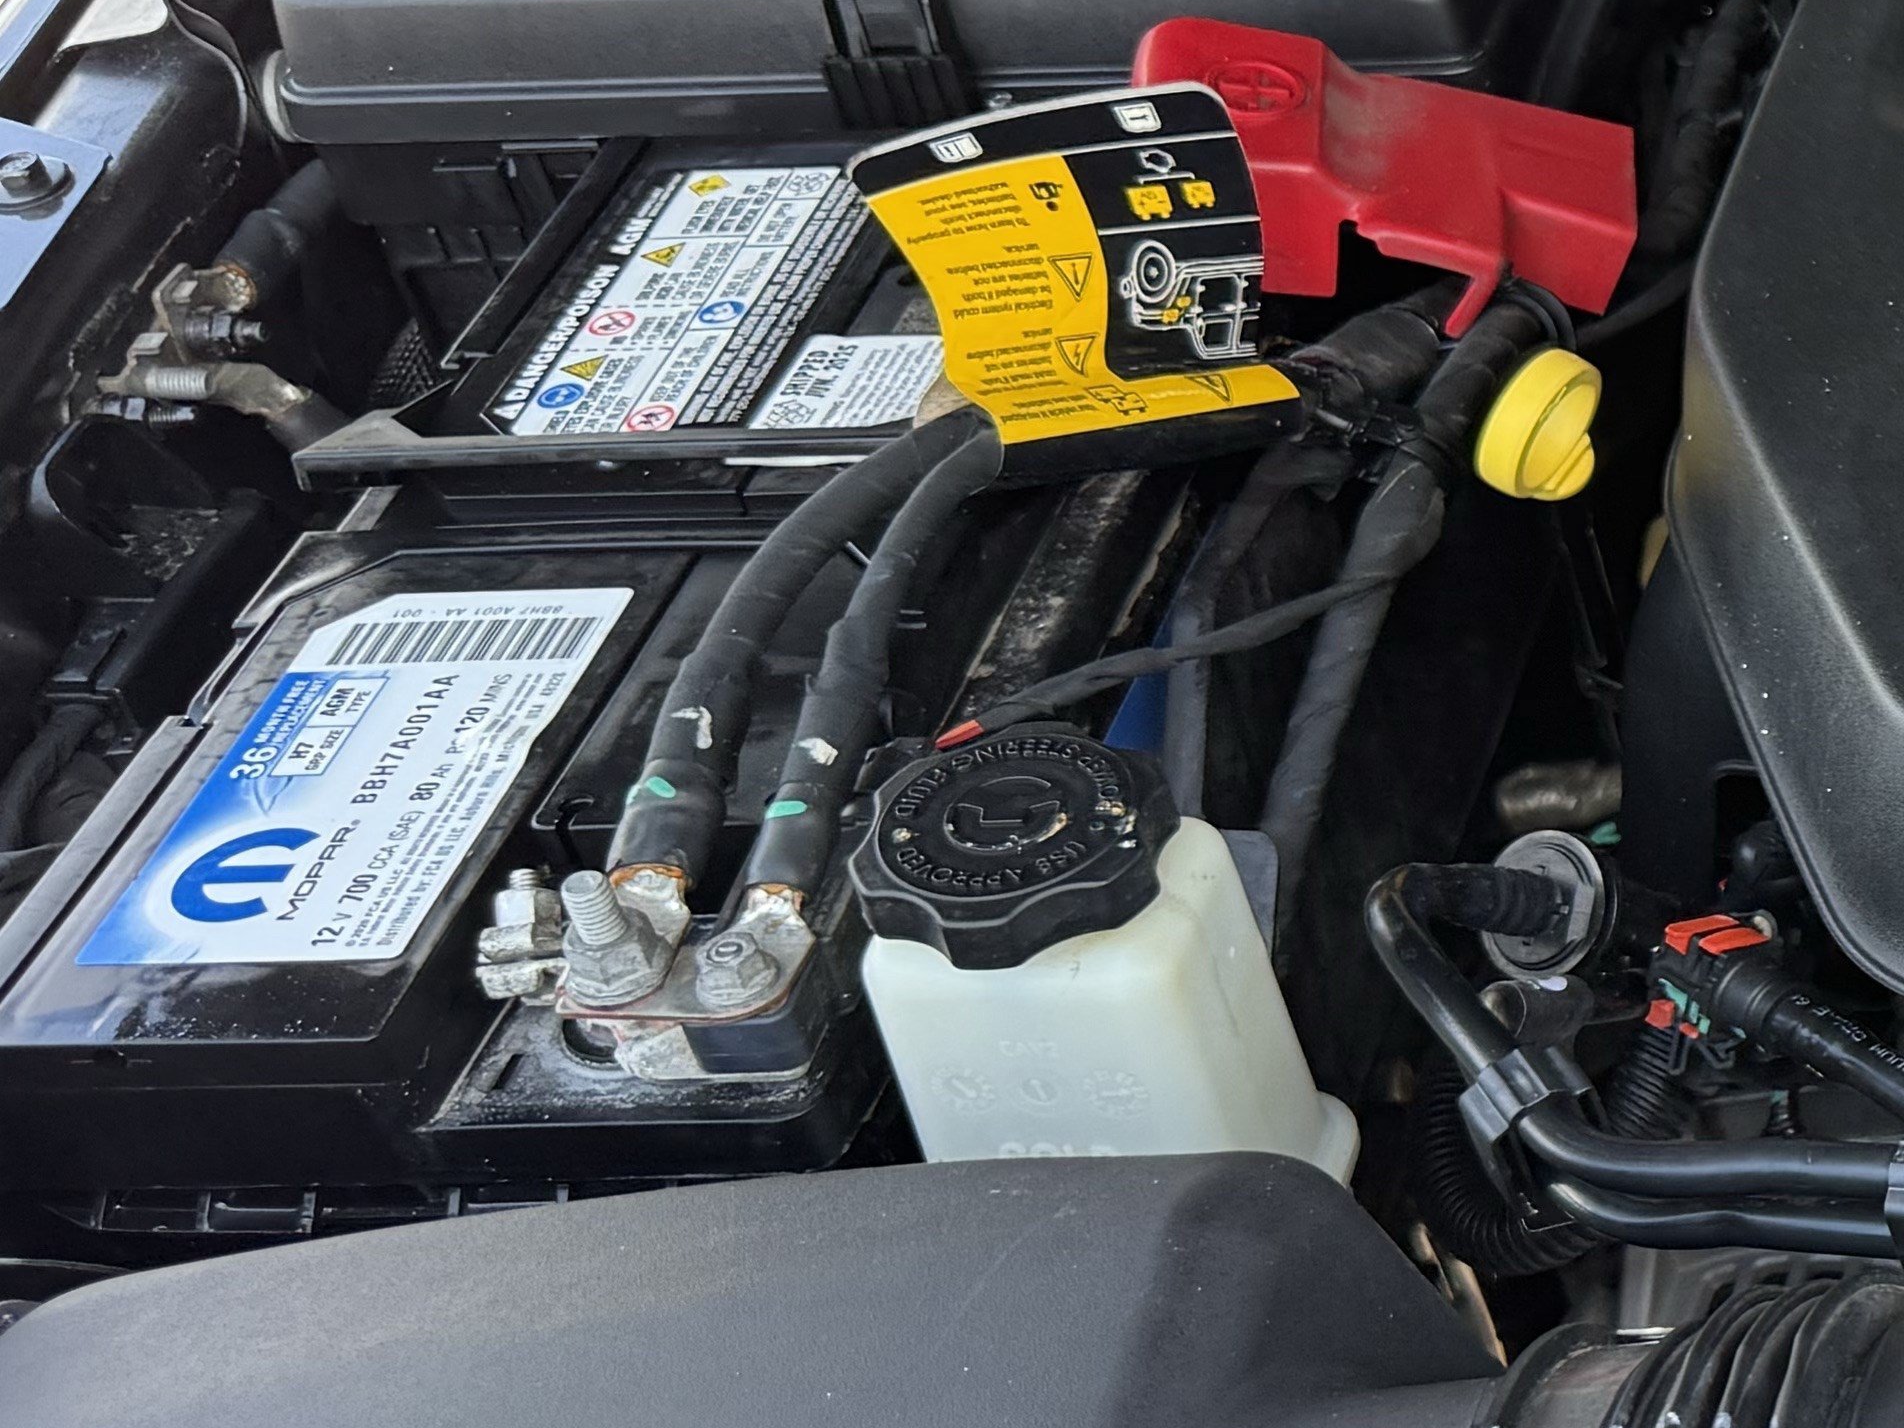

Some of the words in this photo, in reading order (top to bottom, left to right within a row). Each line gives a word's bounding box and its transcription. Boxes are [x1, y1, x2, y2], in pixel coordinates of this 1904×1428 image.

[504, 265, 620, 411] DANGER/POISON
[320, 688, 354, 716] AGM
[345, 690, 371, 712] TYPE
[288, 742, 313, 758] H7
[319, 729, 344, 748] SIZE
[352, 675, 458, 803] BBH7A001AA
[950, 739, 1079, 771] STEERING
[230, 745, 281, 778] 36
[894, 768, 946, 816] FLUID
[311, 926, 344, 945] 12
[338, 873, 377, 903] 700
[367, 844, 399, 869] CCA
[387, 810, 424, 840] (SAE)
[409, 782, 440, 800] 80
[897, 847, 1022, 886] APPROVED
